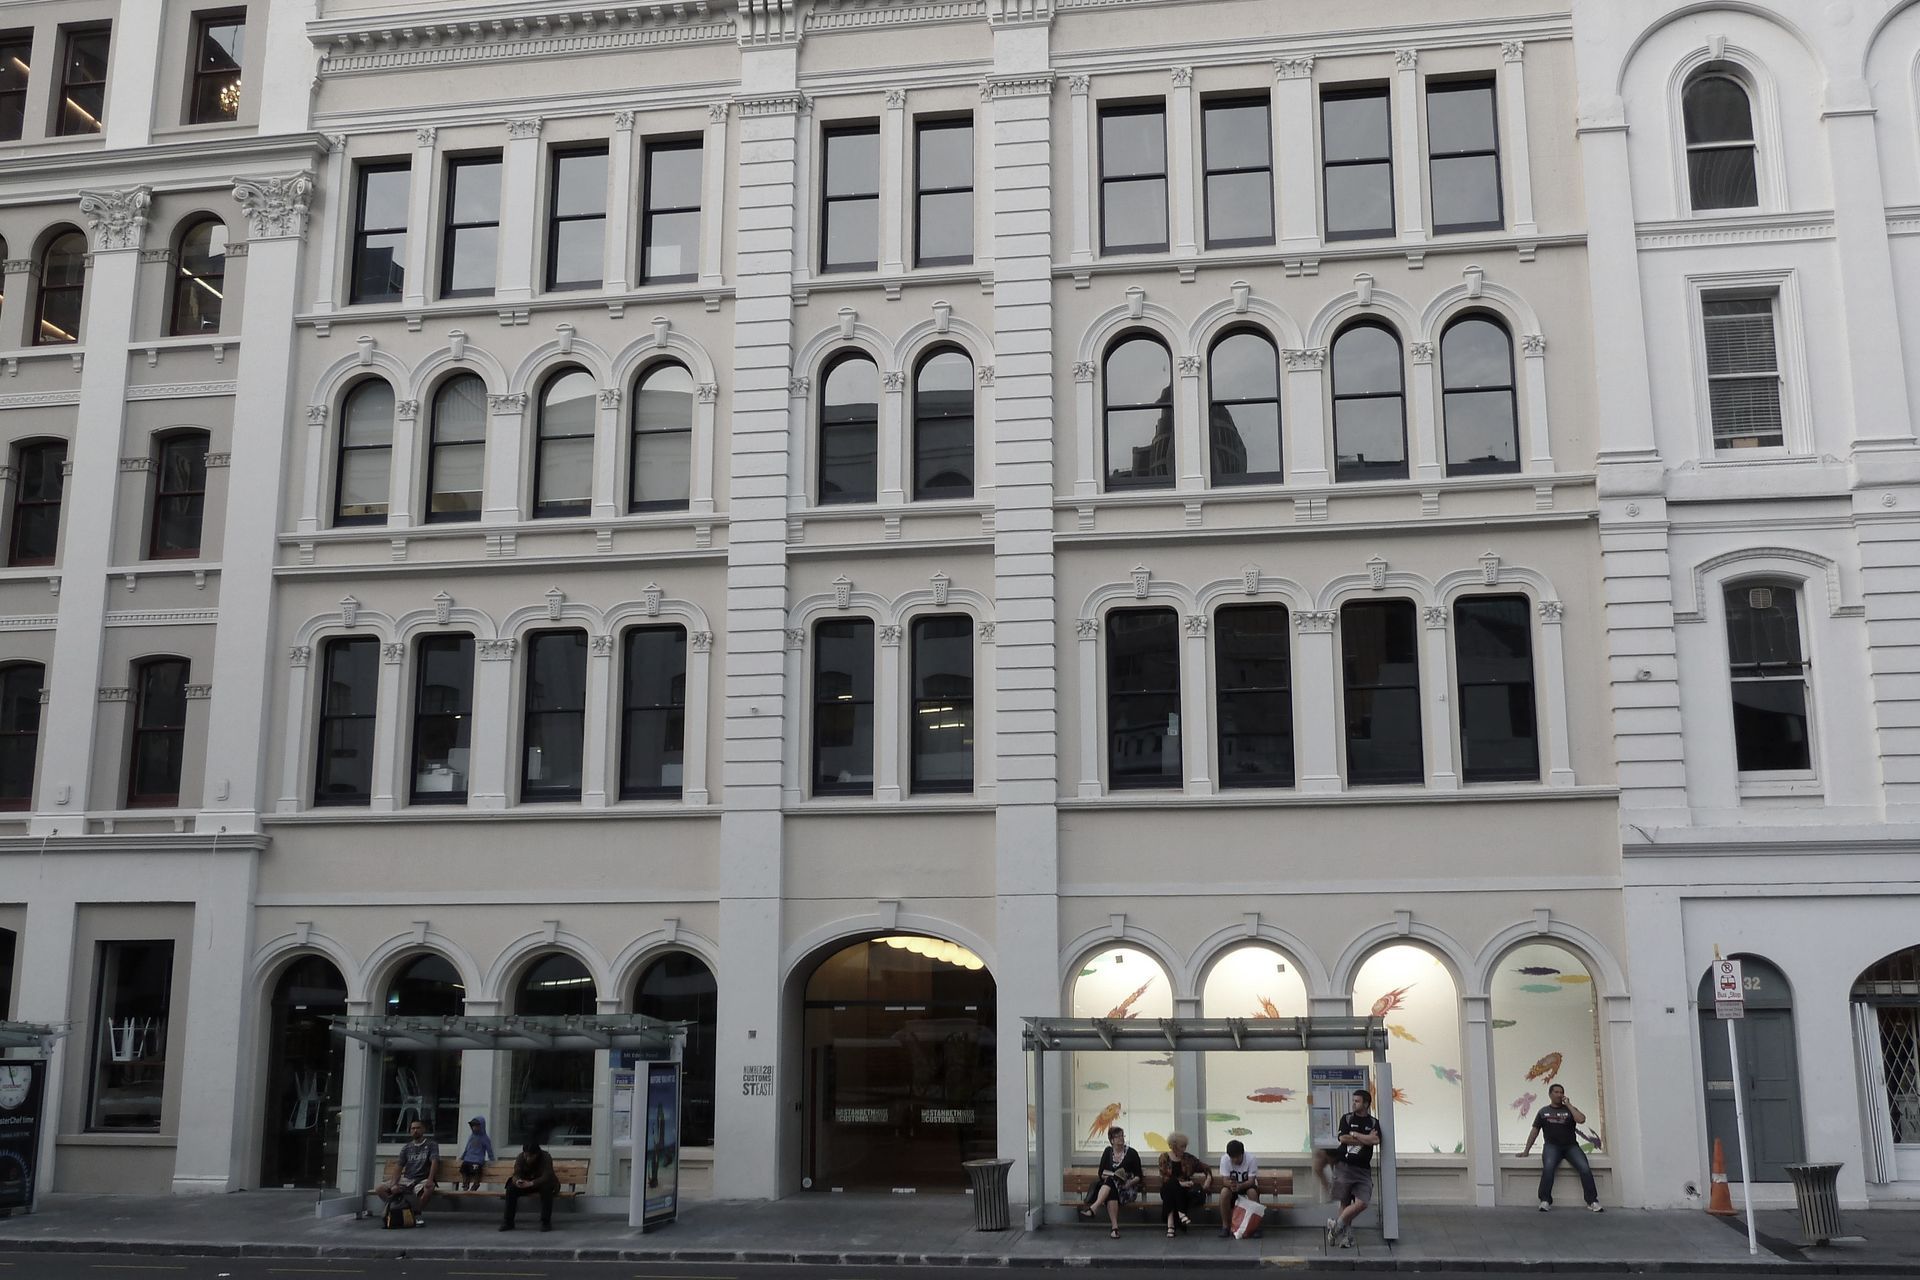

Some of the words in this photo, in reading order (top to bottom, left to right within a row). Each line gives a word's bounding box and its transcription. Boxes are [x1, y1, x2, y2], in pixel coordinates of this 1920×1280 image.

[1744, 976, 1761, 991] 32
[743, 1065, 762, 1074] NUMBER
[762, 1065, 772, 1075] 28
[742, 1074, 772, 1082] CUSTOMS
[742, 1083, 756, 1096] ST
[756, 1083, 772, 1096] EAST
